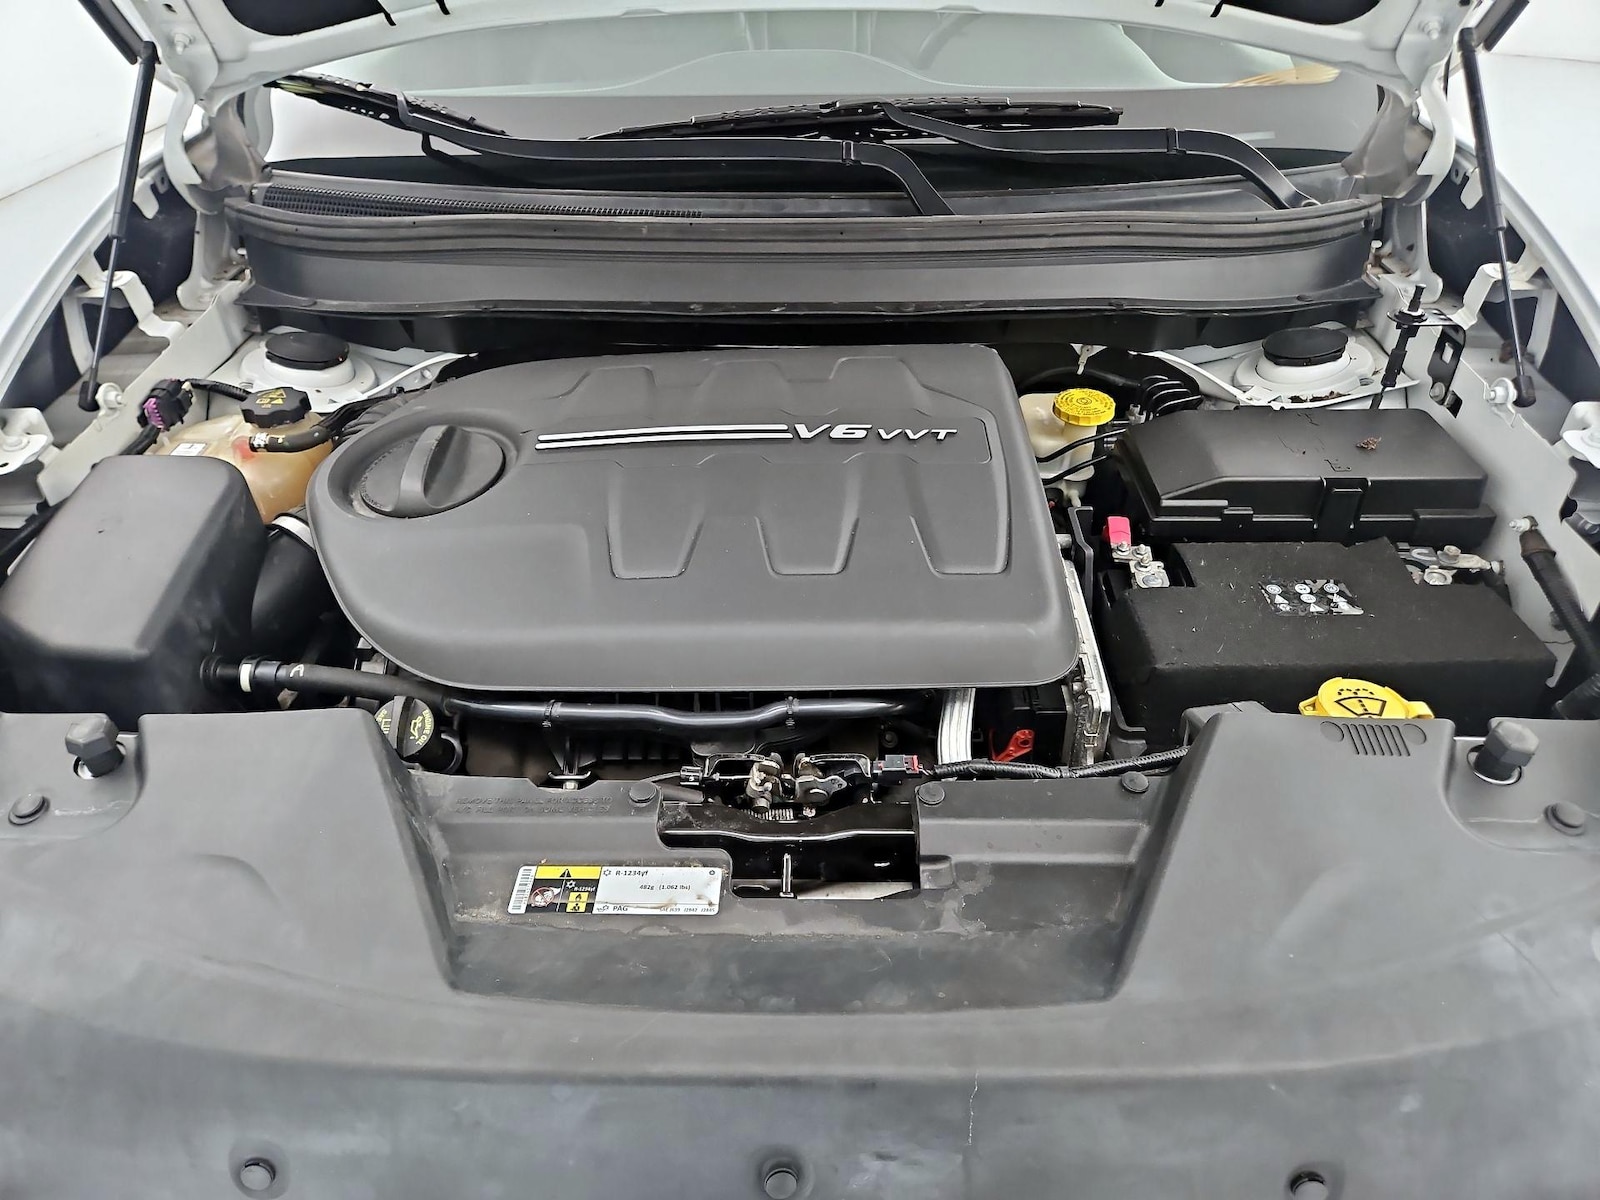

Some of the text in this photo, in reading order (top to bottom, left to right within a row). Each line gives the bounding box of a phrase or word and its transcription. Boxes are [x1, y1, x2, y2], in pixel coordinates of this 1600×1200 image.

[794, 423, 958, 441] V6 VVT
[415, 709, 432, 746] ENGINE OIL
[615, 869, 649, 877] R-1234yf
